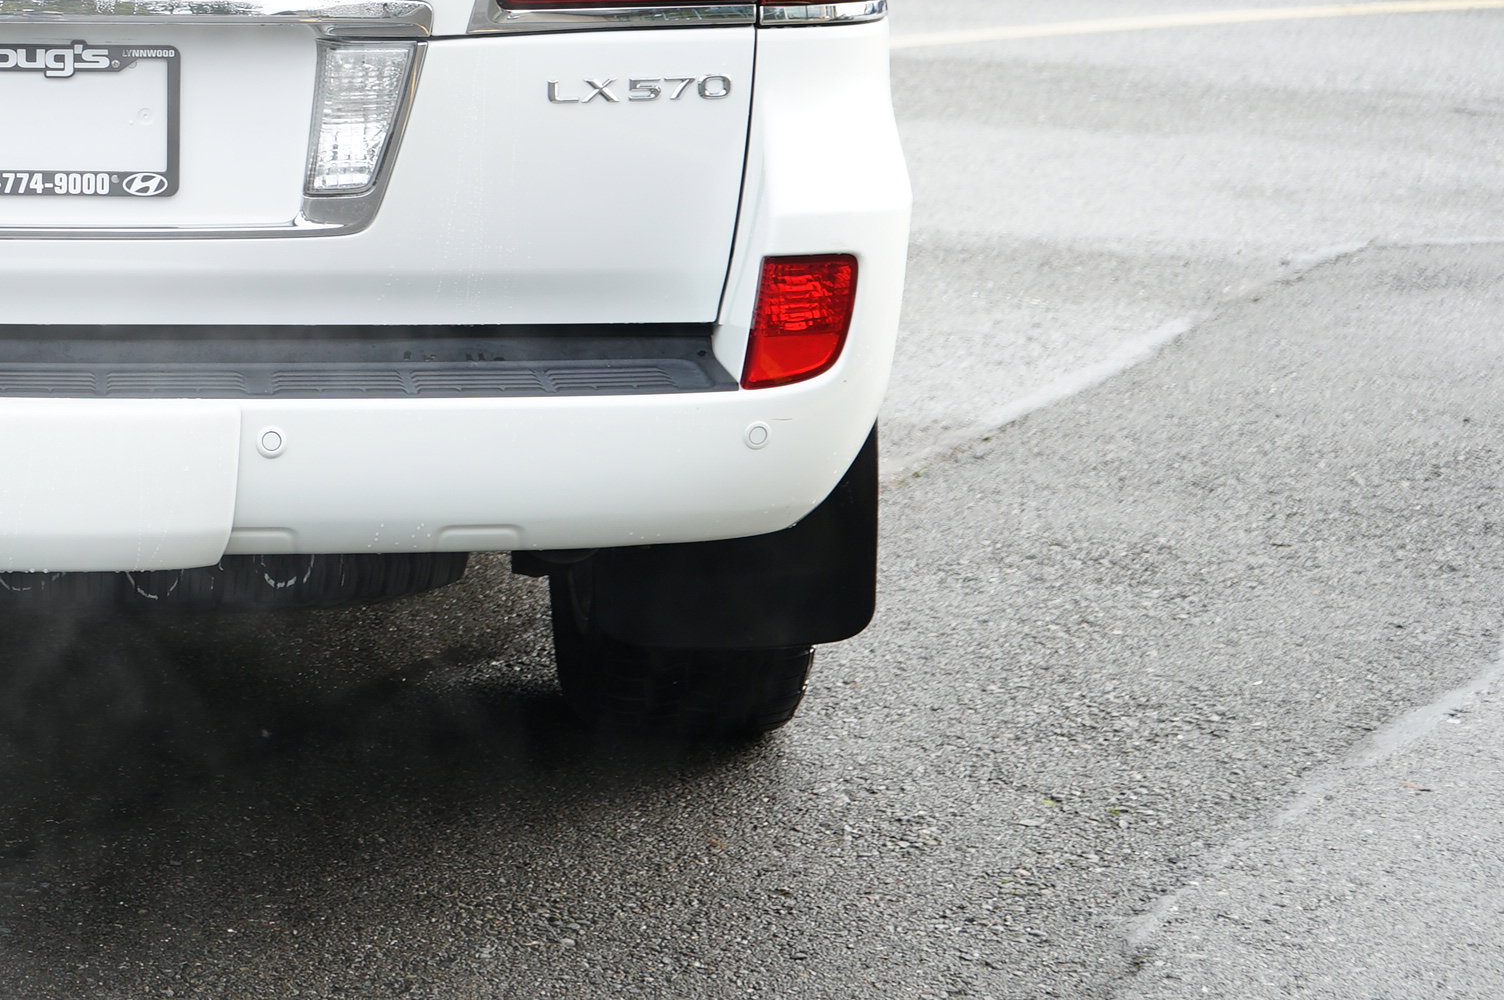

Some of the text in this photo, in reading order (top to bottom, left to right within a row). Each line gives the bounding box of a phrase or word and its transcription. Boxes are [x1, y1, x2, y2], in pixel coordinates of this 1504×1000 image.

[122, 49, 175, 58] LYNNWOOD
[546, 73, 732, 104] LX 570
